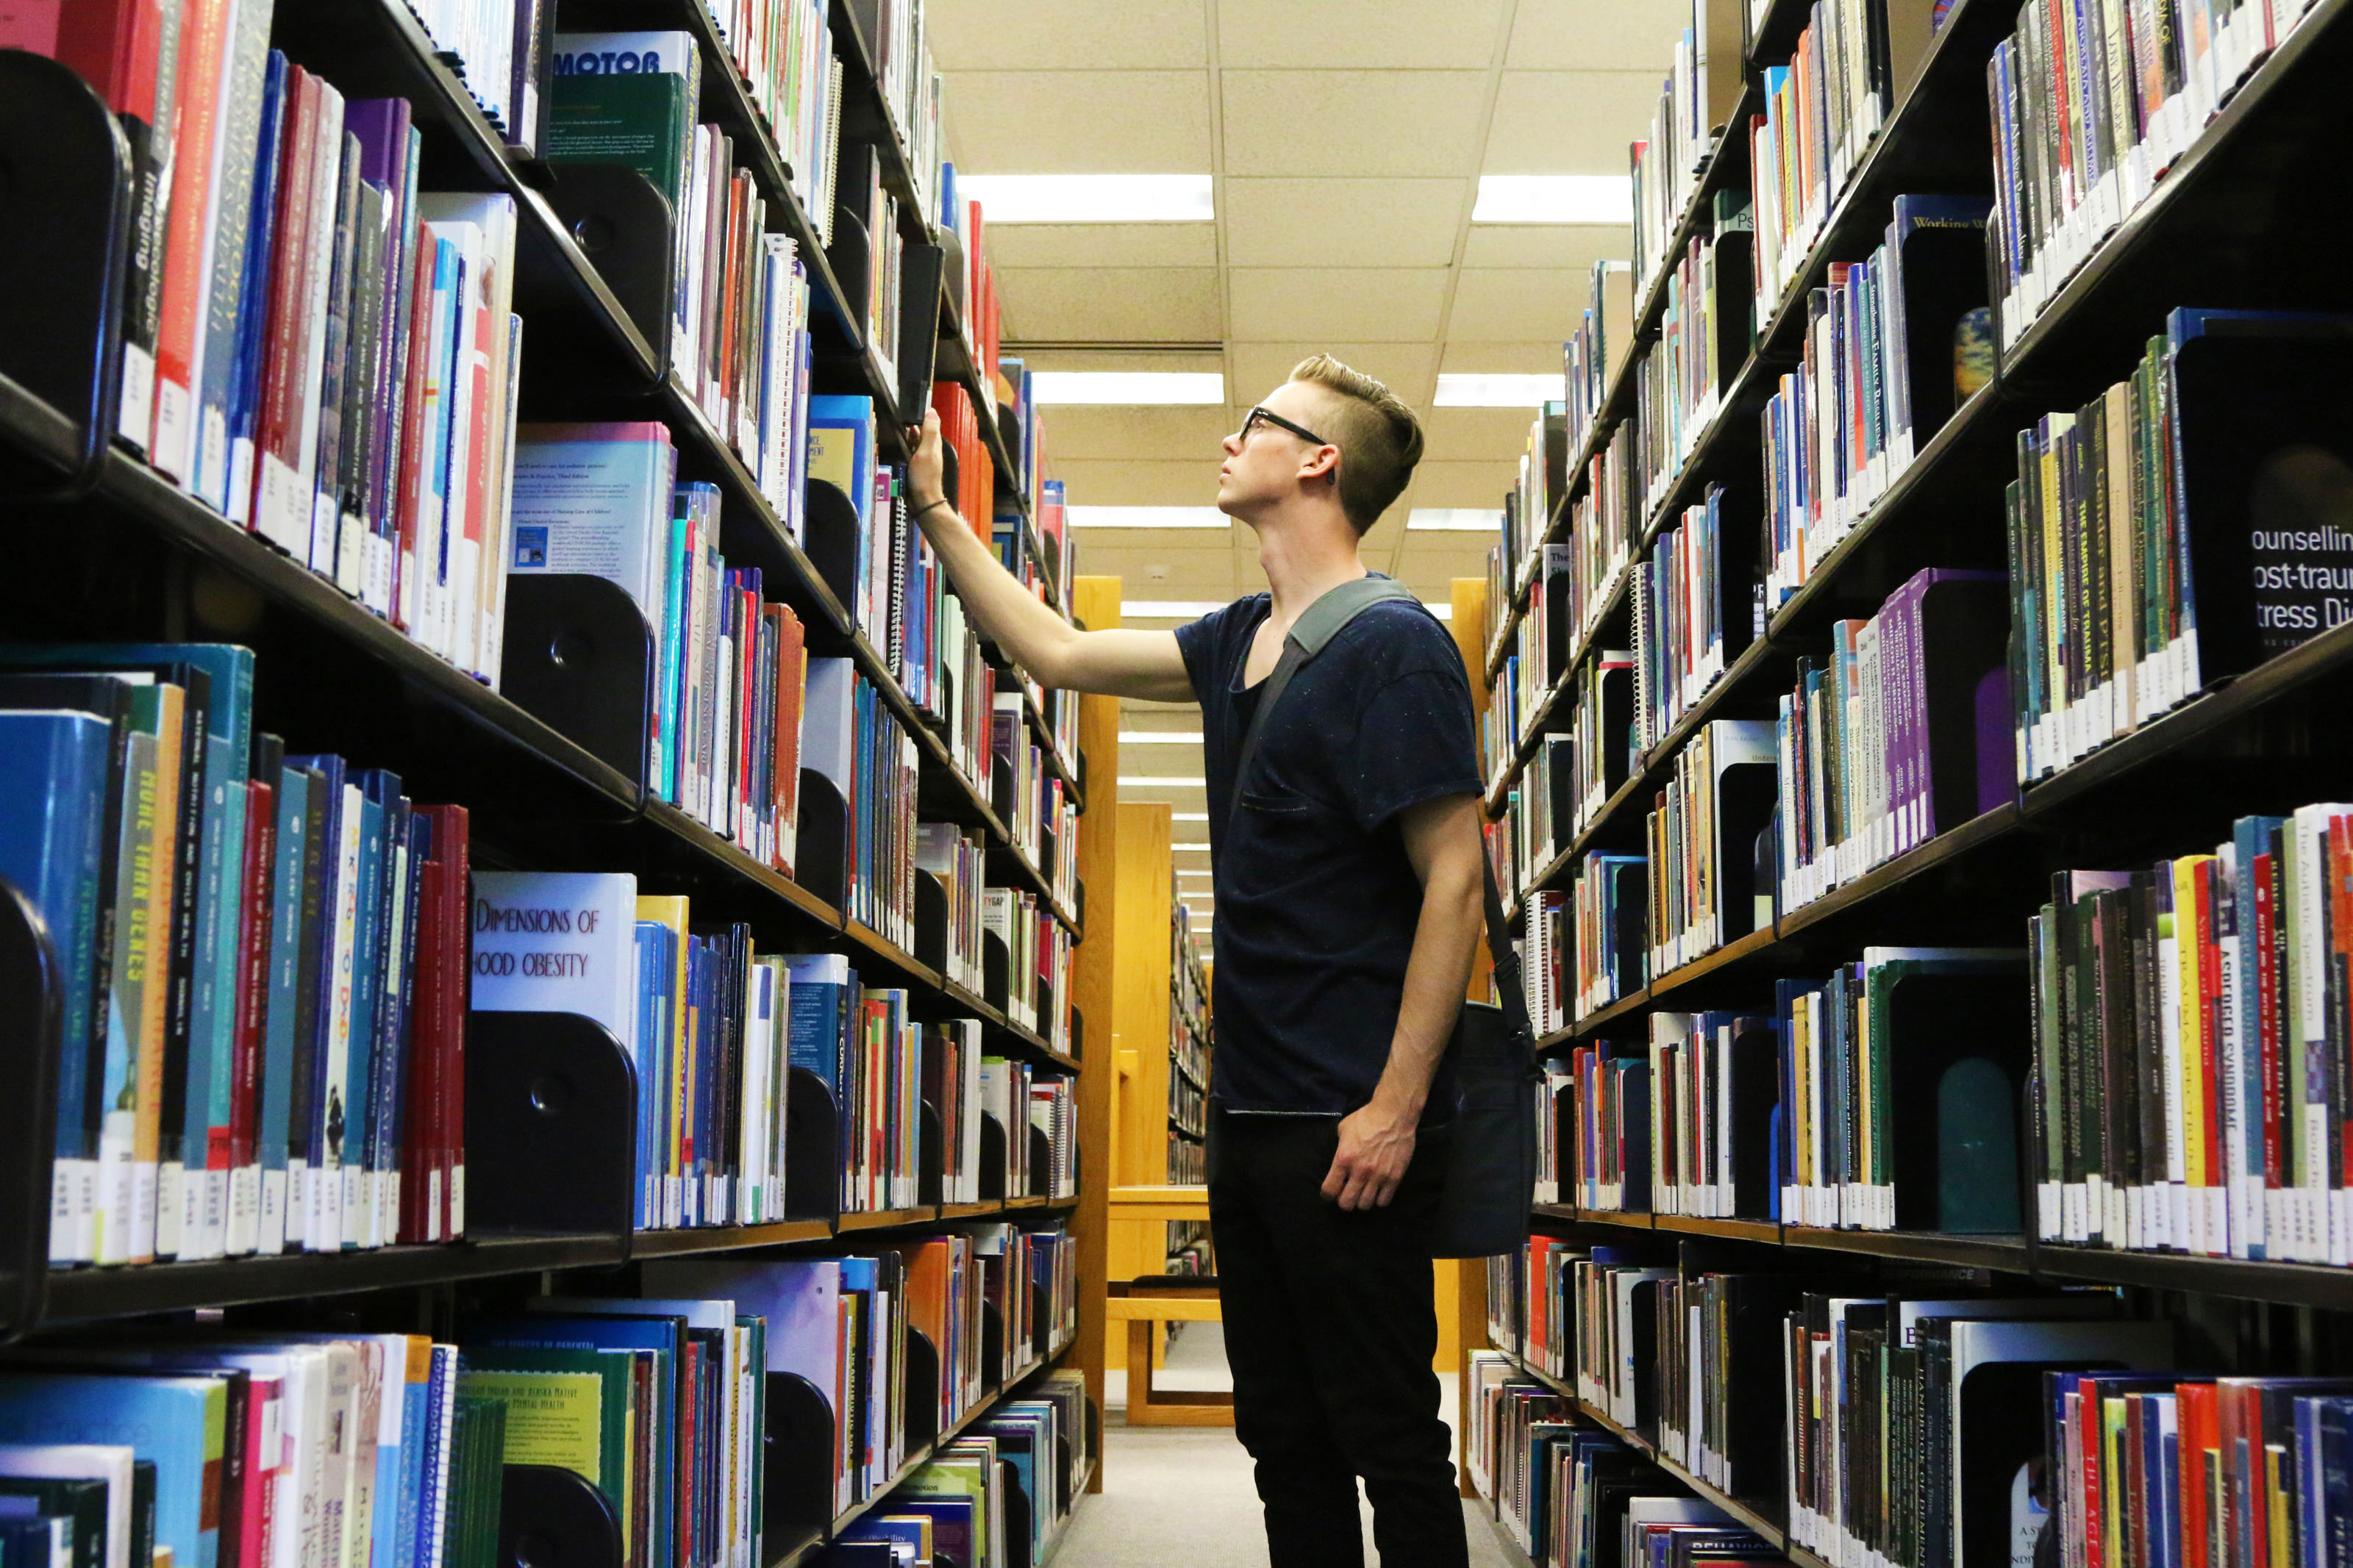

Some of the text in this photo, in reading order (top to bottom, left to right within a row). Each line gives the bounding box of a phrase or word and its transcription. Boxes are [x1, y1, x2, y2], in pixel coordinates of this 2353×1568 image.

[553, 51, 660, 75] MOTOR
[685, 102, 696, 163] MOTOR
[2082, 93, 2093, 126] AND
[2008, 85, 2025, 261] The Abusive Personality
[135, 171, 158, 271] Imaging
[1868, 284, 1882, 385] Strengthening FAMILY
[385, 381, 402, 523] Digital Mammography
[1551, 553, 1569, 562] The
[2096, 468, 2107, 608] Gender and
[2079, 501, 2093, 673] THE EMPIRE OF TRAUMA
[1901, 676, 1910, 737] ERICKSON
[179, 710, 204, 957] MATERNAL NUTRITION AND CHILD HEALTH
[1783, 776, 1792, 830] Mindfulness
[128, 770, 157, 981] MORE THAN GENES
[476, 898, 600, 934] DIMENSIONS OF
[2258, 913, 2266, 946] AUTISM
[2299, 824, 2315, 1022] The Autistic Spectrum
[522, 953, 588, 977] OBESITY
[2179, 950, 2190, 1044] TRAUMA
[2198, 915, 2210, 1067] Voices of Trauma
[2288, 956, 2299, 1021] Autism
[2338, 1062, 2347, 1113] Disorder
[513, 1399, 565, 1410] MENTAL HEALTH
[527, 1387, 552, 1397] ALASKA
[554, 1387, 577, 1397] NATIVE
[1797, 1387, 1806, 1473] Schizophrenia
[1927, 1441, 1935, 1461] Day
[2086, 1454, 2098, 1548] THE AGE
